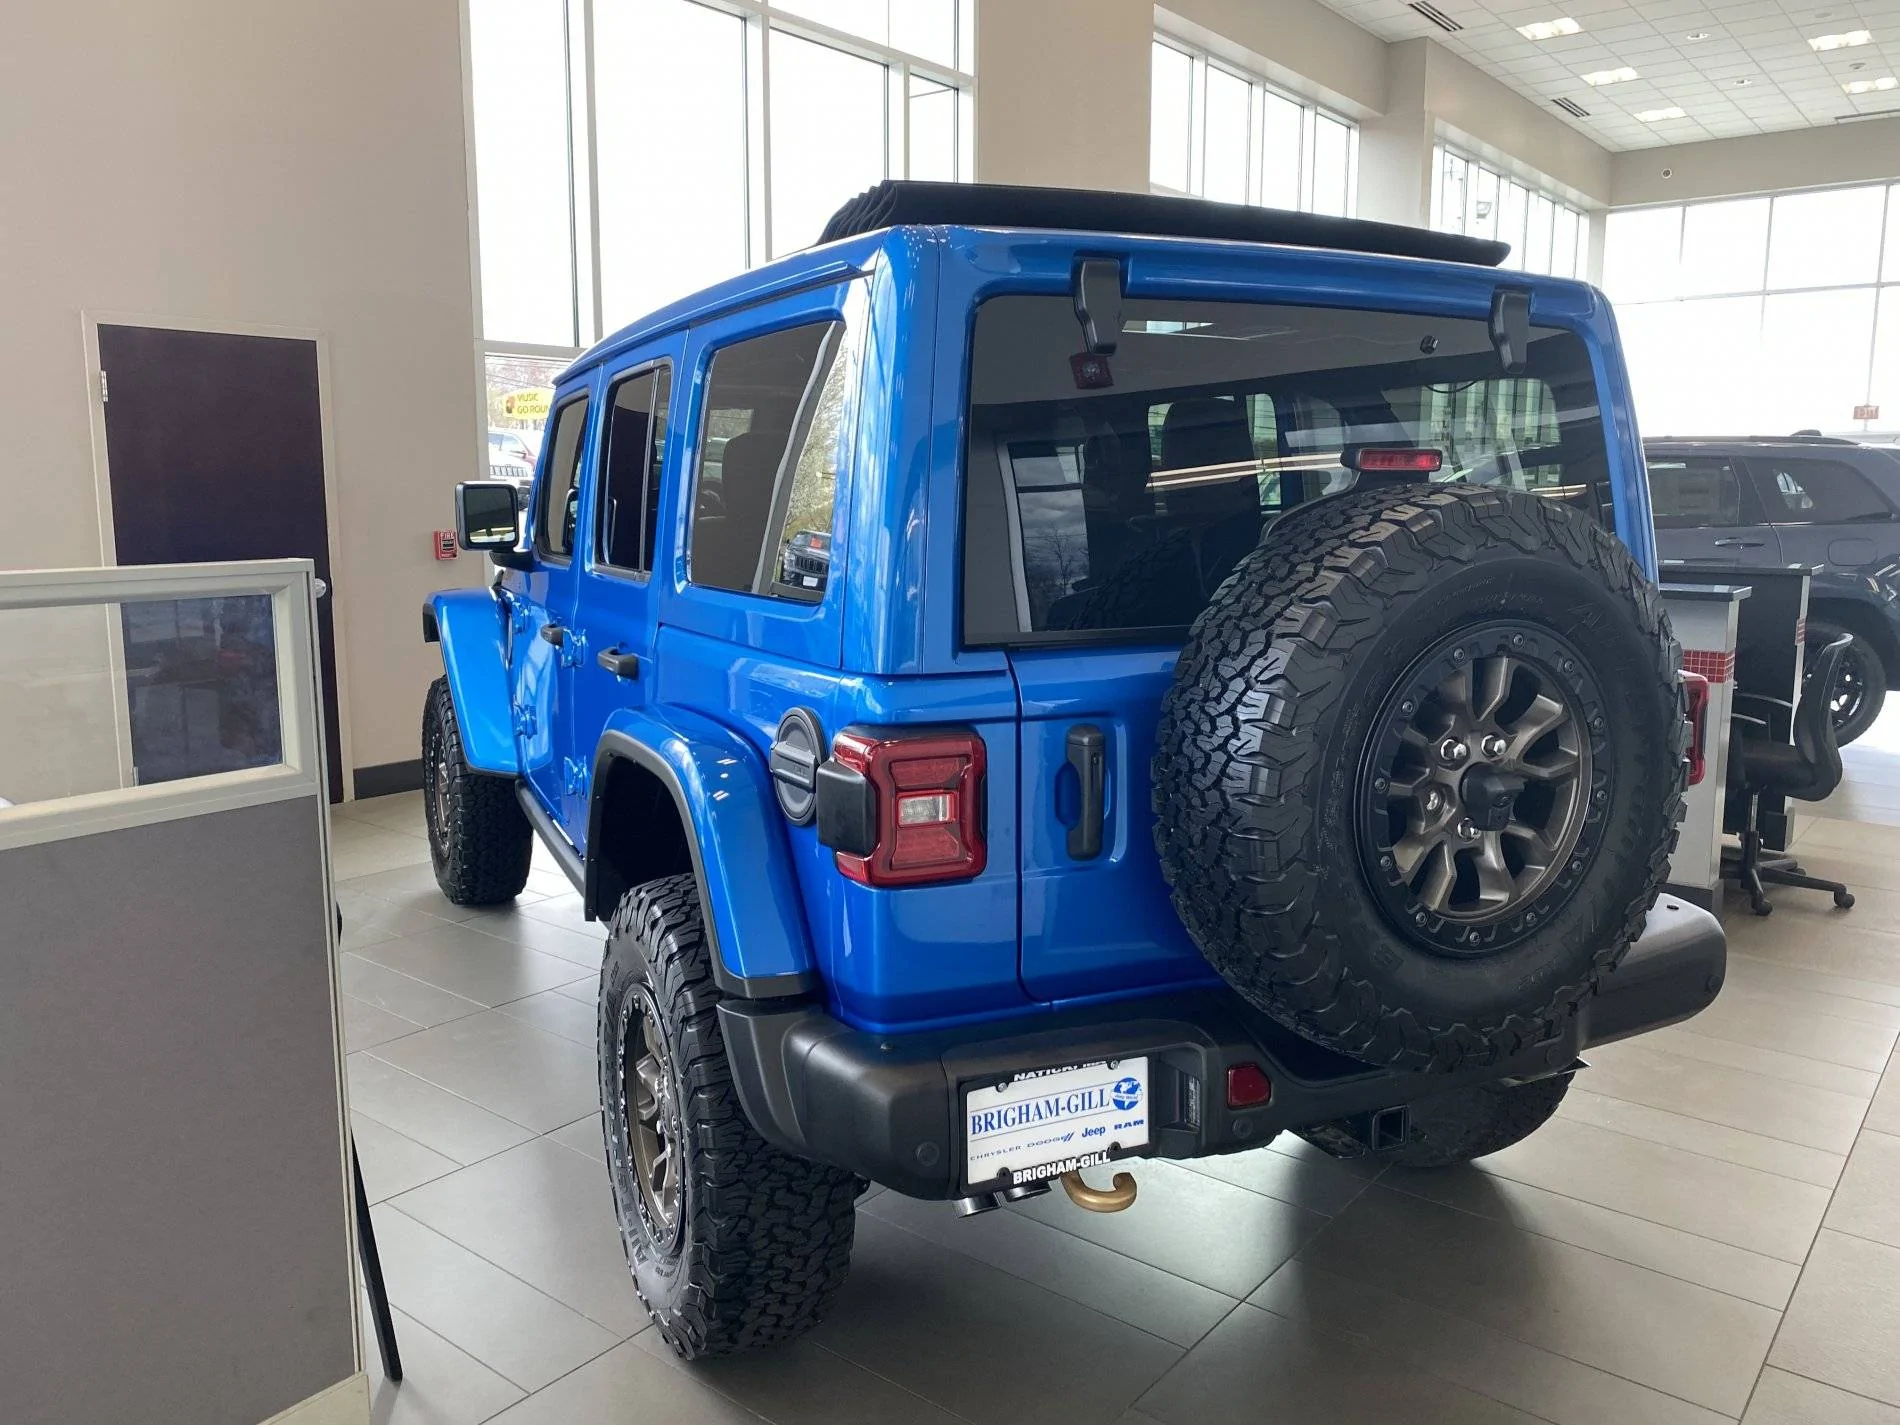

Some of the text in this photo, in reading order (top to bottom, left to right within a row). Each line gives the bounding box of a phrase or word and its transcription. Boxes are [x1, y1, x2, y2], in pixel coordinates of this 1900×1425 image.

[517, 405, 529, 414] GO
[971, 1088, 1110, 1135] BRIGHAM-GILL
[970, 1145, 1022, 1160] CHRYSLER
[1081, 1126, 1106, 1138] Jeep
[1114, 1119, 1145, 1131] RAM
[1013, 1151, 1111, 1184] BRIGHAM-GILL
